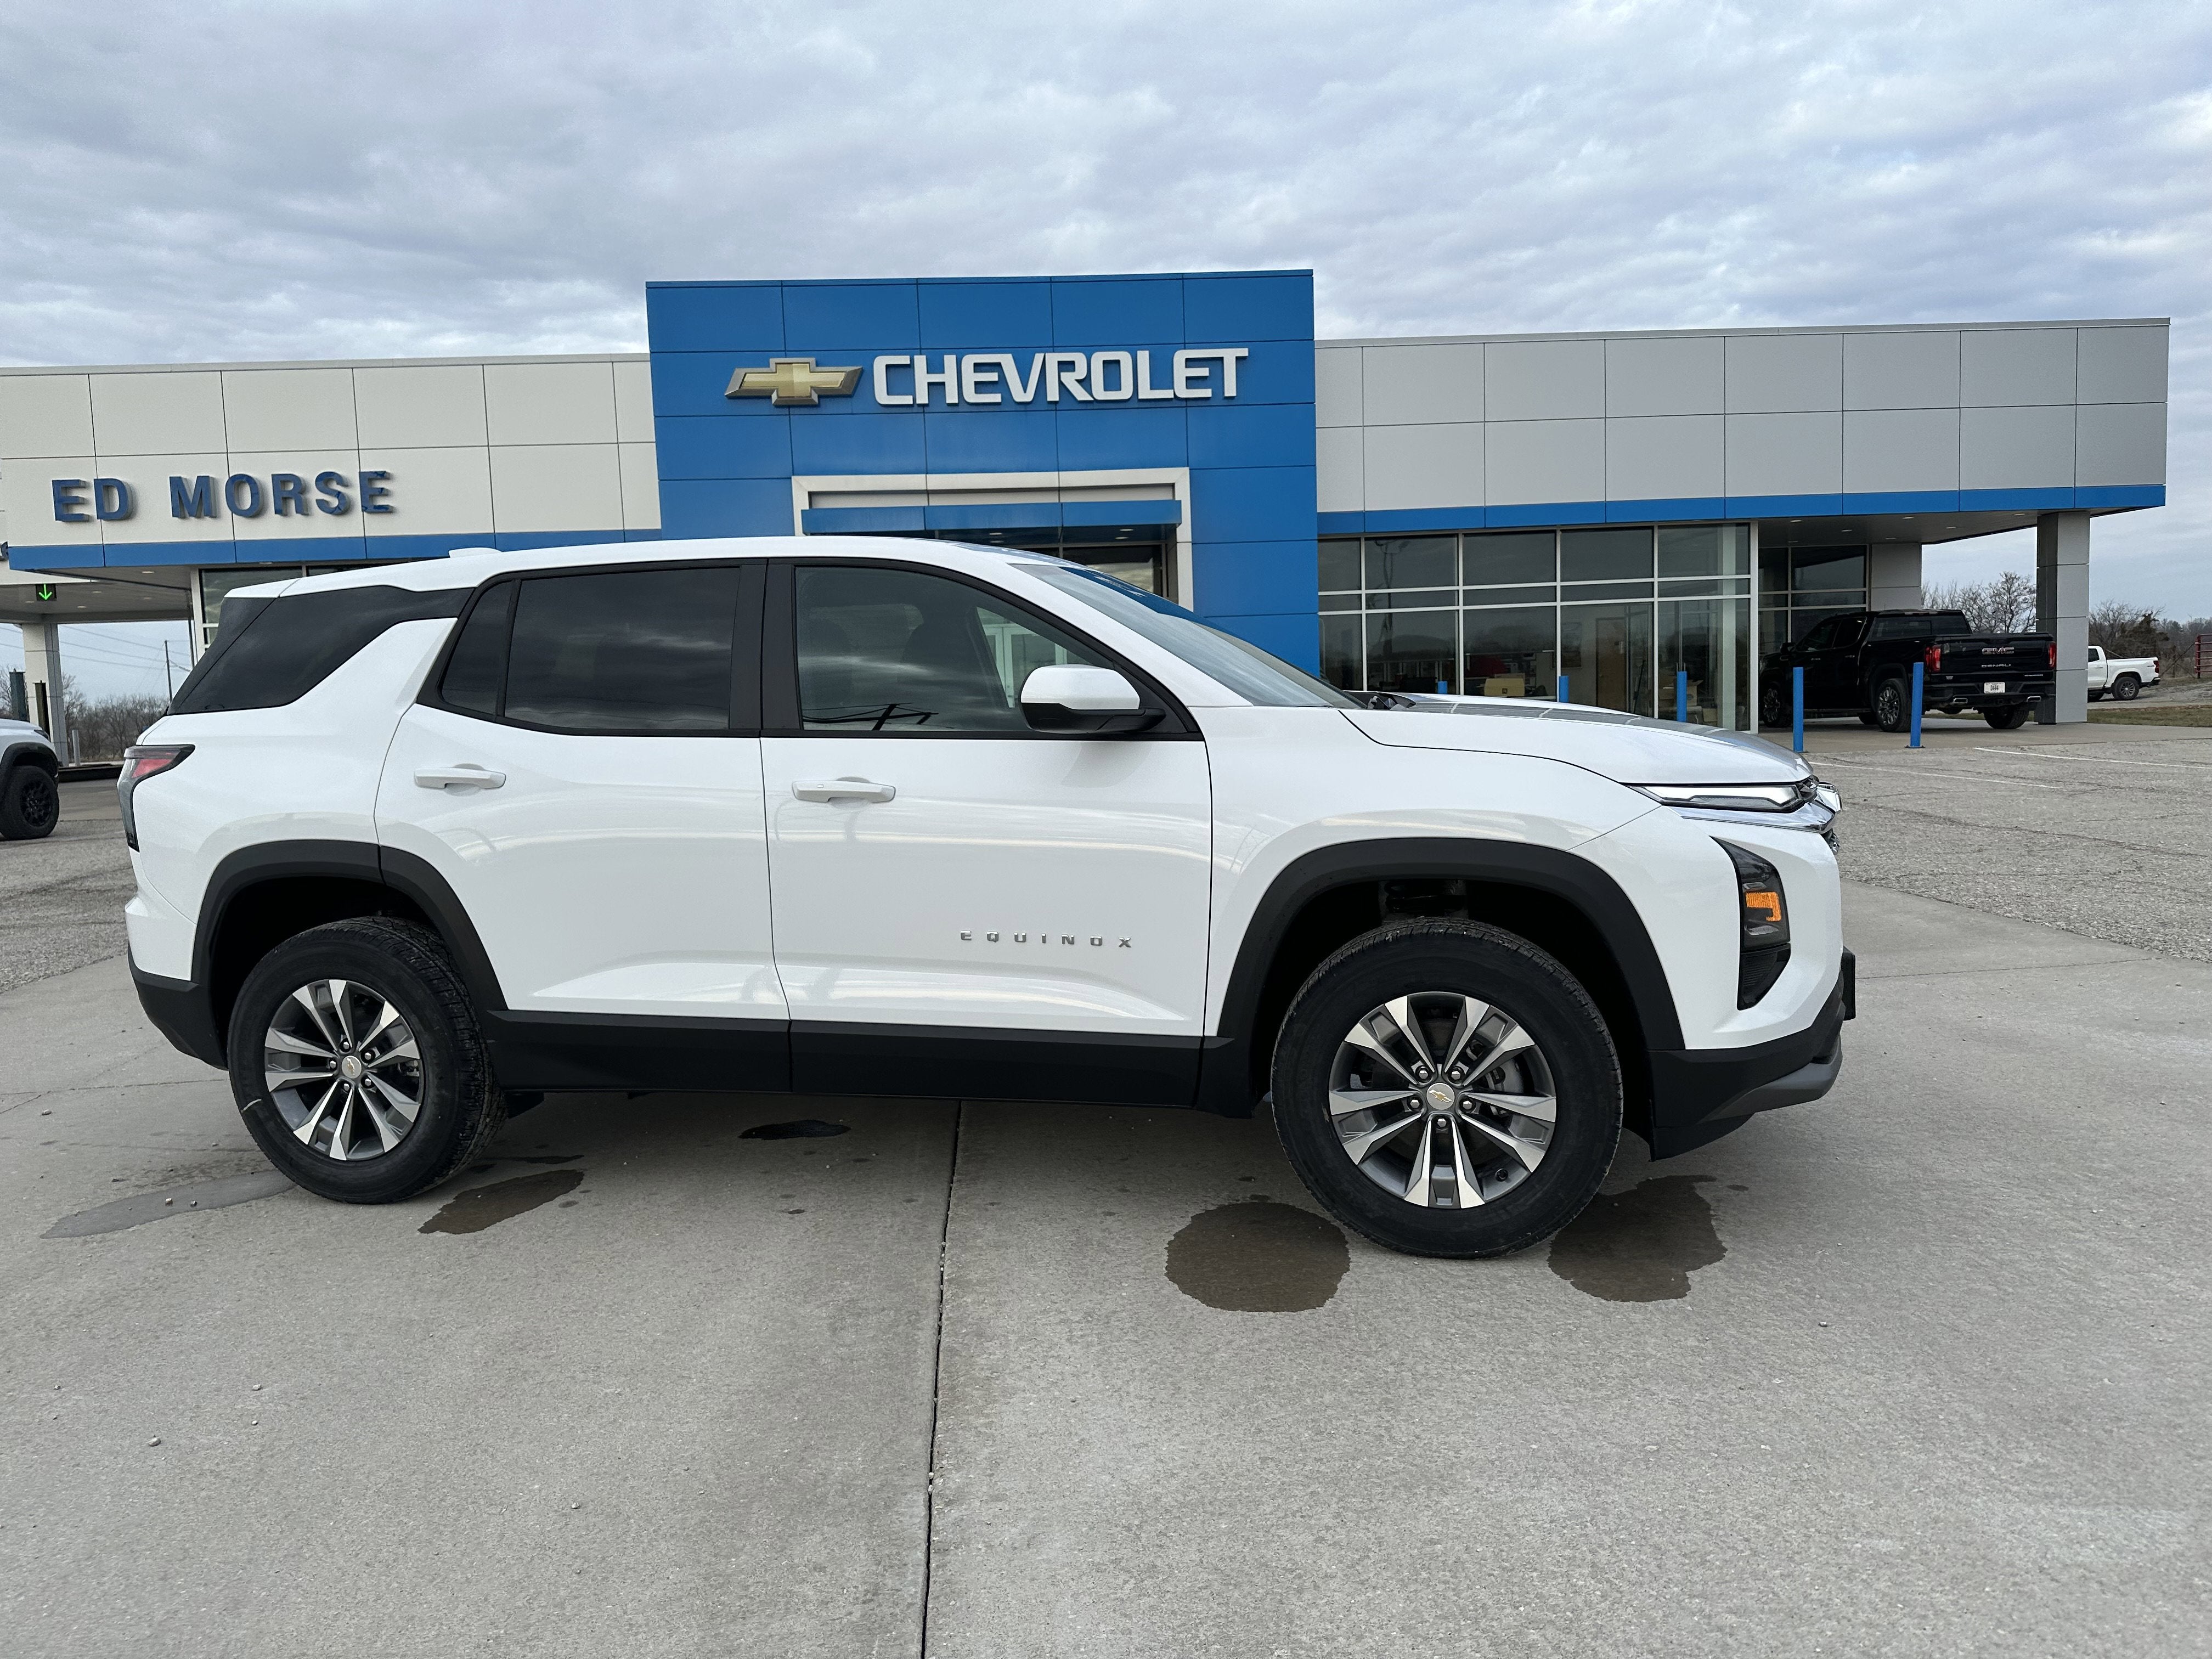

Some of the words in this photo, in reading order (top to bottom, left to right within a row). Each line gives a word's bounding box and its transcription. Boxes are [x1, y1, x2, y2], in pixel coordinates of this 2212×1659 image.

[873, 348, 1249, 405] CHEVROLET
[52, 478, 135, 522] ED
[169, 471, 395, 518] MORSE
[1982, 647, 2015, 655] GMC
[961, 930, 1131, 947] EQUINOX
